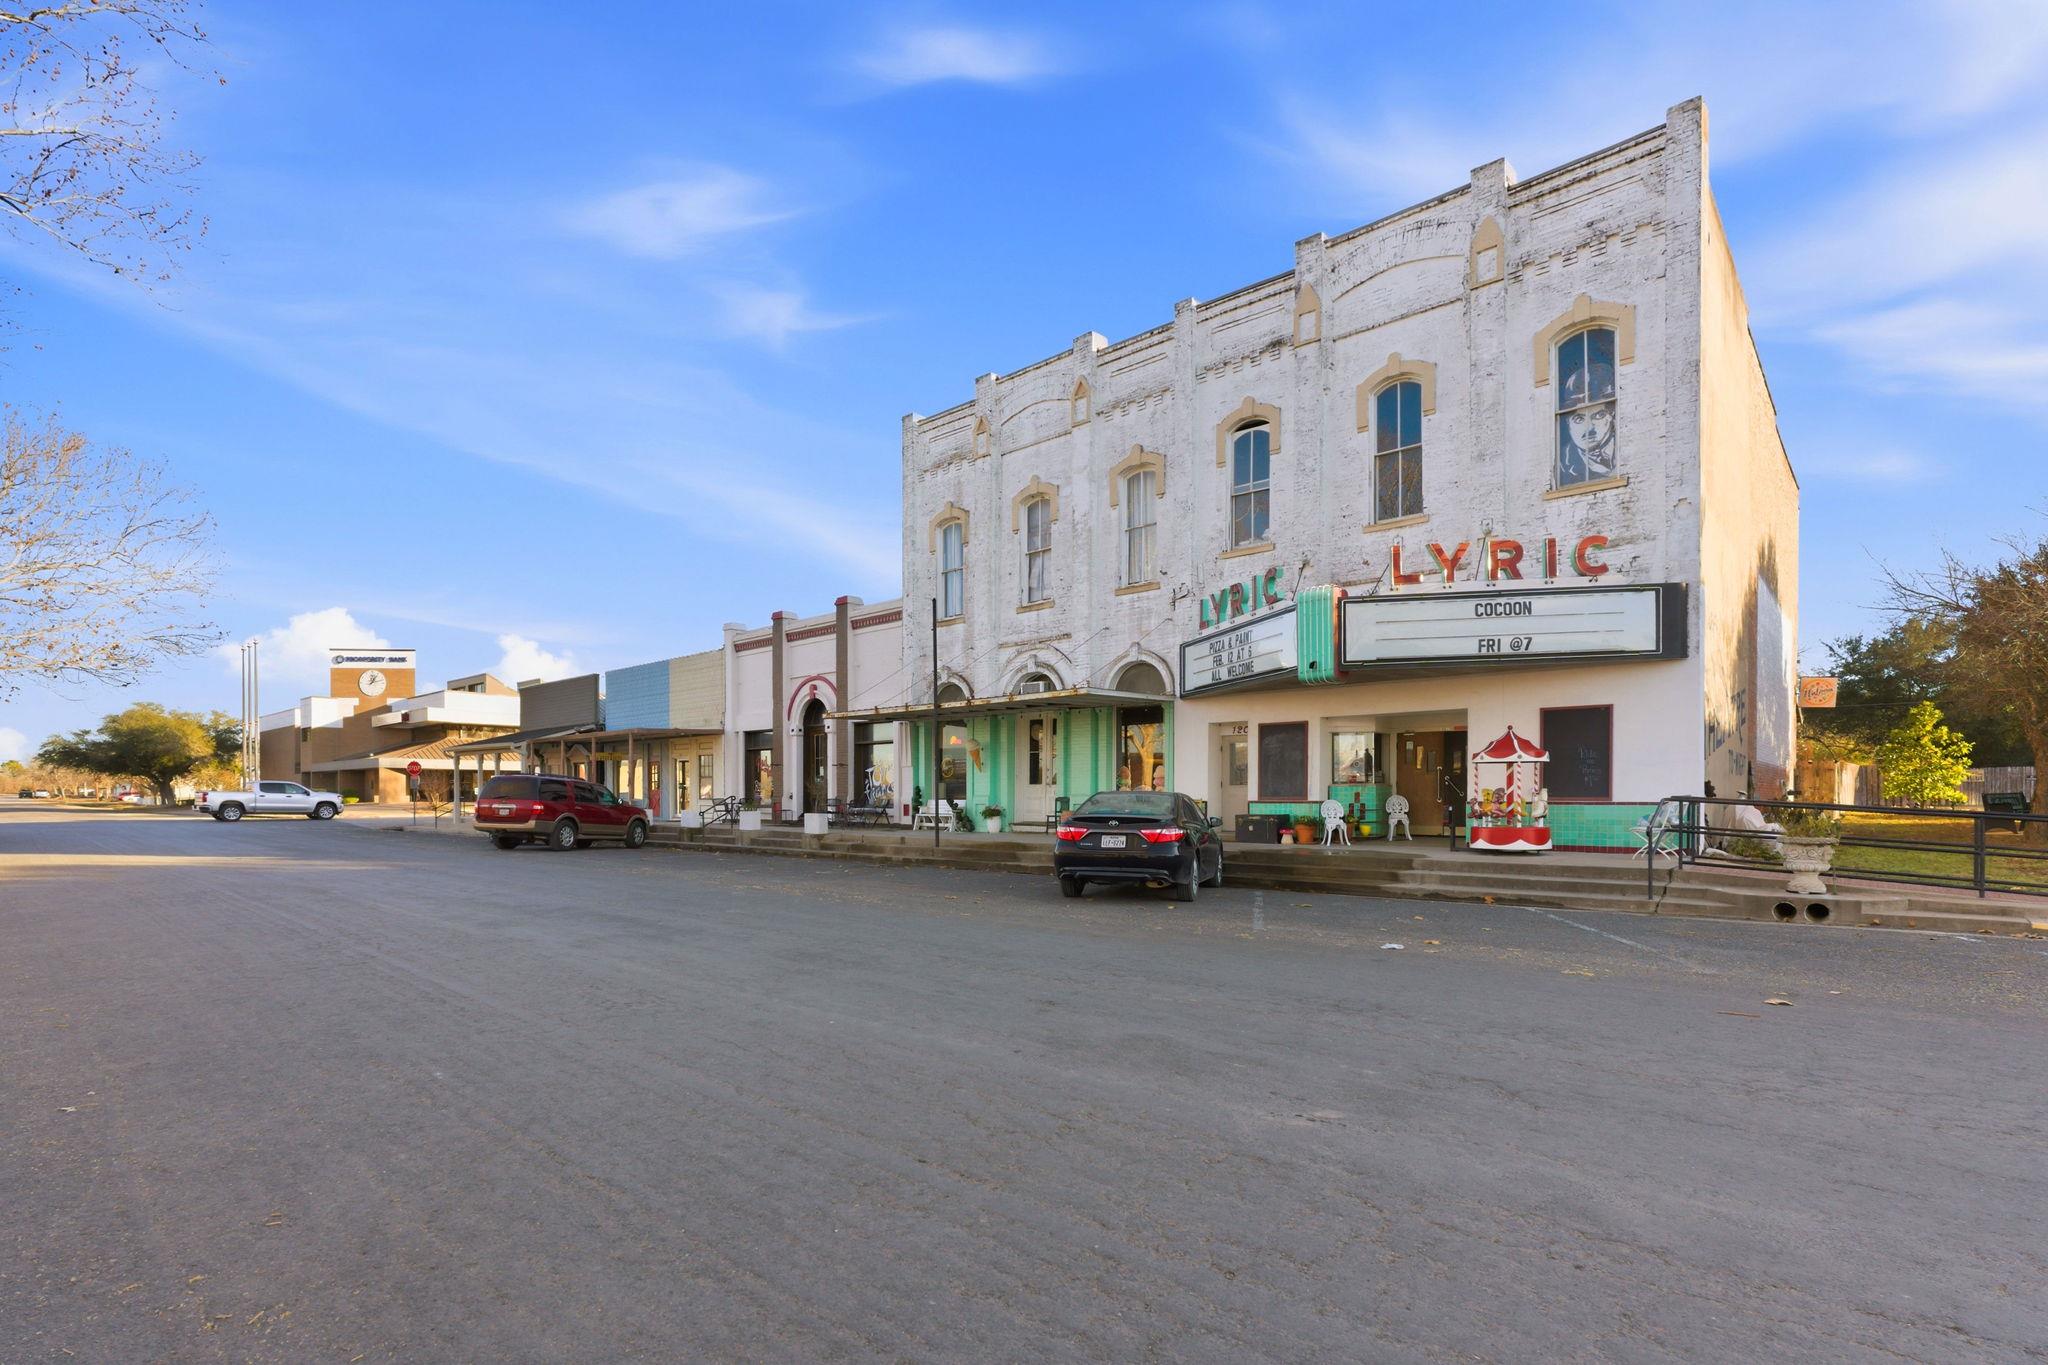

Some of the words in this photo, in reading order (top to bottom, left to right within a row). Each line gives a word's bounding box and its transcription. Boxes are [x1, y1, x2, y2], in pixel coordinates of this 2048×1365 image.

[1390, 534, 1609, 585] LYRIC
[1199, 566, 1284, 631] LYRIC
[1474, 601, 1532, 617] COCOON
[1209, 639, 1225, 654] PIZZA
[1228, 636, 1233, 649] &
[1235, 630, 1253, 647] PAINT
[1478, 638, 1501, 653] FRI
[1509, 637, 1533, 652] @7
[1227, 651, 1234, 663] 12
[1236, 647, 1245, 661] AT
[1211, 668, 1222, 682] ALL
[1227, 660, 1254, 678] WELCOME
